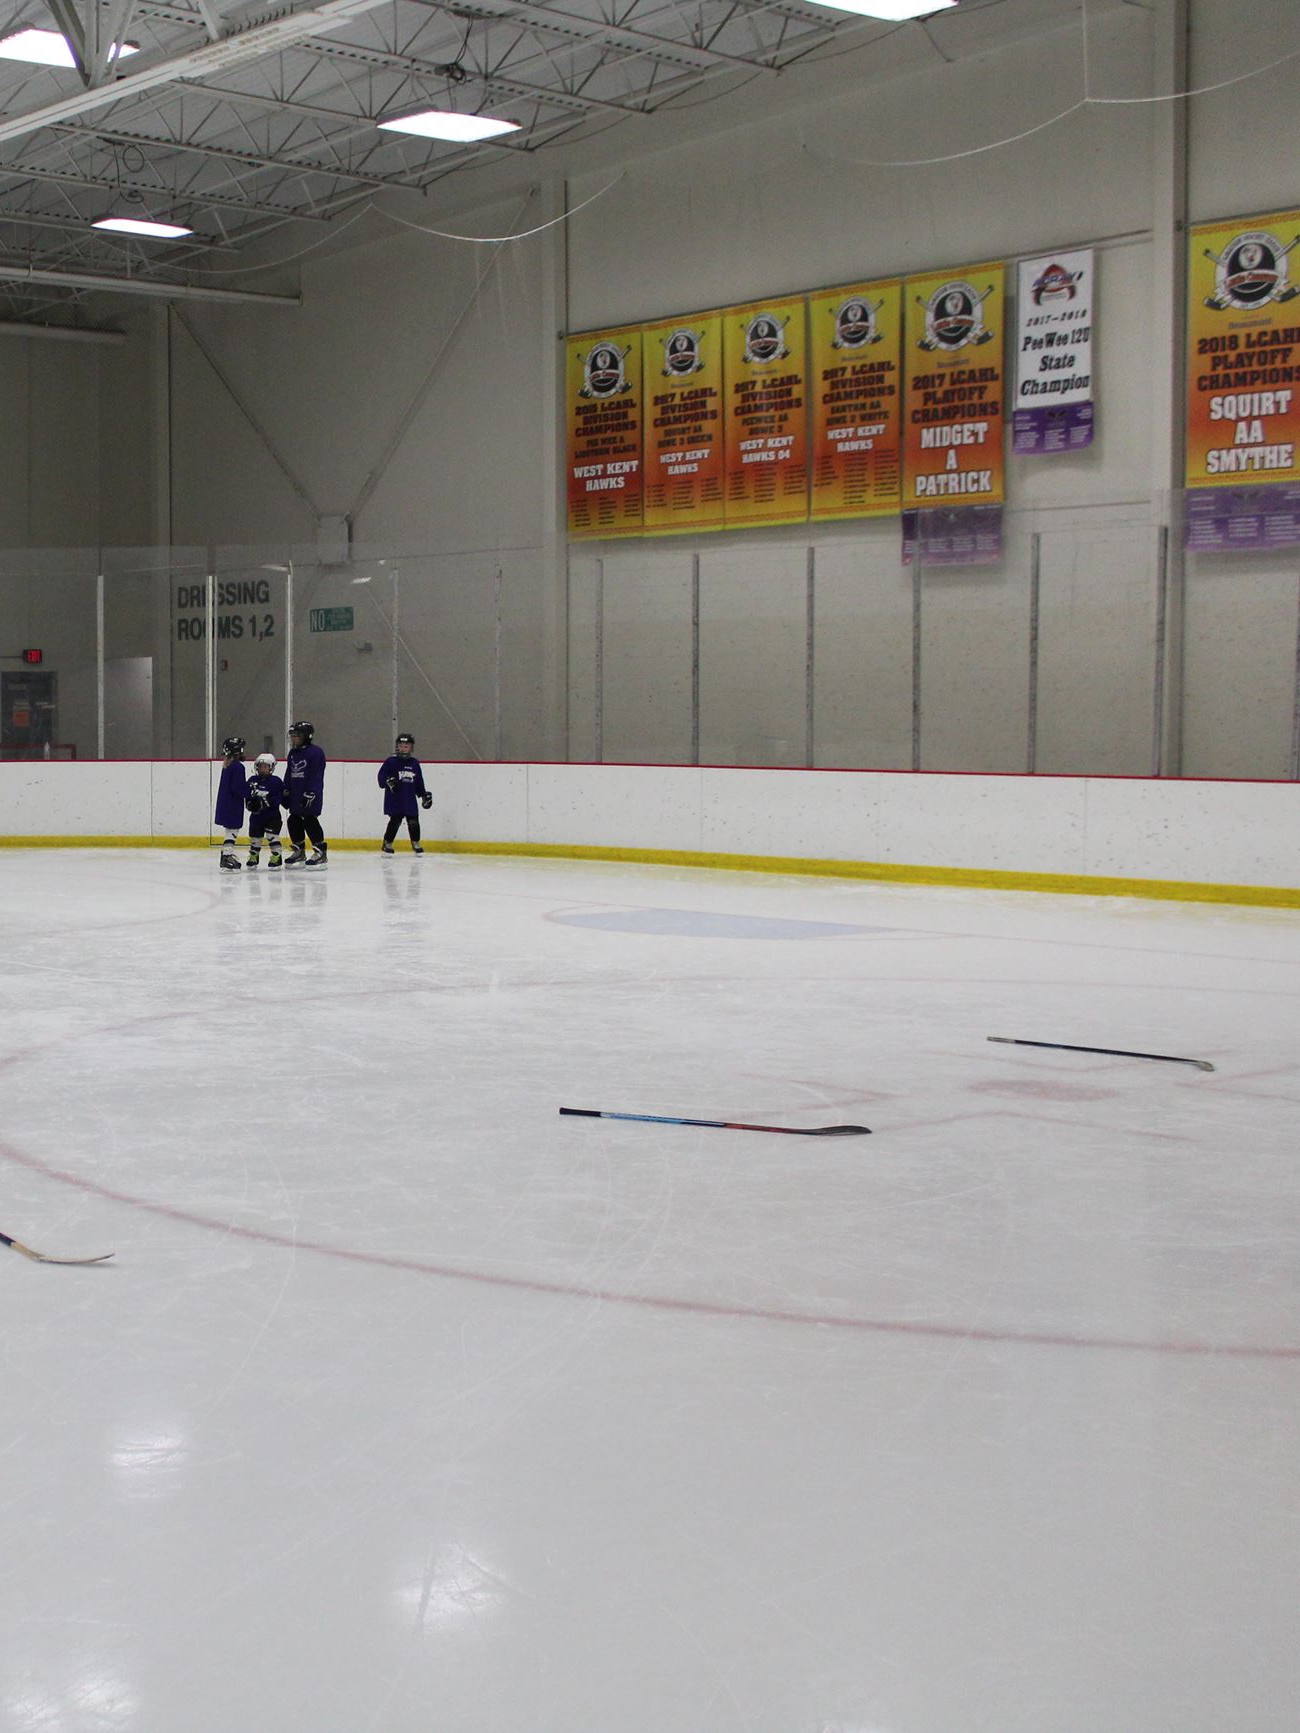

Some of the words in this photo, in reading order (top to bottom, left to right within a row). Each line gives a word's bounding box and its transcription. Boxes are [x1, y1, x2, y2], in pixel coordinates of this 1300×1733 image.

[1197, 335, 1238, 355] 2018
[1039, 354, 1076, 373] State
[1211, 347, 1292, 371] PLAYOFF
[911, 373, 946, 391] 2017
[1020, 375, 1091, 396] Champion
[923, 385, 988, 406] PLAYOFF
[1210, 389, 1292, 420] SQUIRT
[910, 401, 1001, 425] CHAMPIONS
[827, 427, 854, 441] WEST
[857, 423, 886, 438] KENT
[919, 422, 989, 449] MIDGET
[1234, 420, 1265, 444] AA
[740, 439, 765, 452] WEST
[767, 436, 795, 449] KENT
[837, 438, 874, 453] HAWKS
[742, 450, 776, 464] HAWKS
[945, 448, 958, 470] A
[1206, 443, 1293, 474] SMYTHE
[573, 464, 604, 479] WEST
[607, 460, 639, 475] KENT
[586, 476, 626, 492] HAWKS
[915, 470, 992, 497] PATRICK
[311, 610, 326, 631] NO
[27, 650, 41, 664] EXIT
